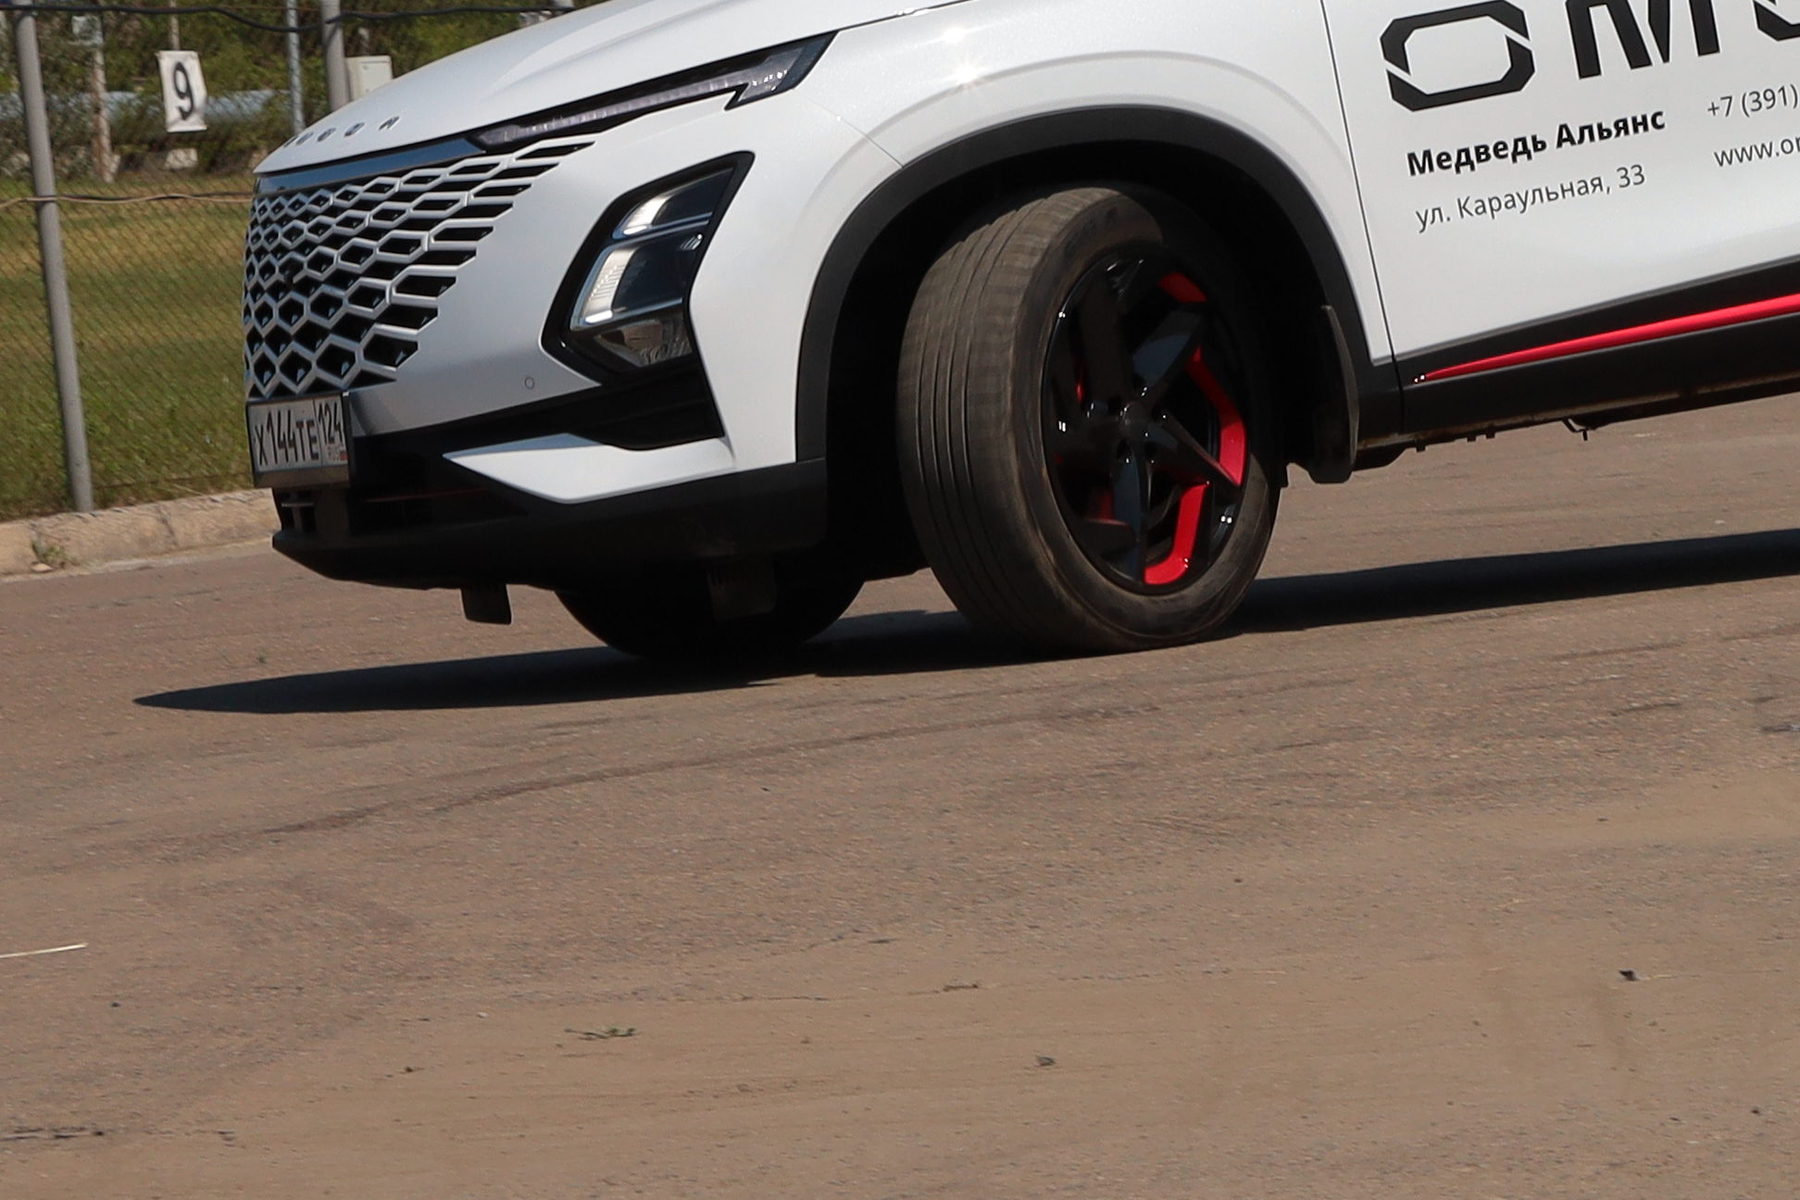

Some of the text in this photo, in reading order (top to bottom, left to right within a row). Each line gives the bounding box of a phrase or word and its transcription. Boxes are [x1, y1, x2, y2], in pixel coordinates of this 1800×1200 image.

[173, 61, 194, 121] 9
[1707, 96, 1734, 118] +7
[1741, 84, 1799, 118] (391)
[1406, 110, 1666, 176] Медведь Альянс
[1415, 163, 1647, 234] ул. Караульная, 33
